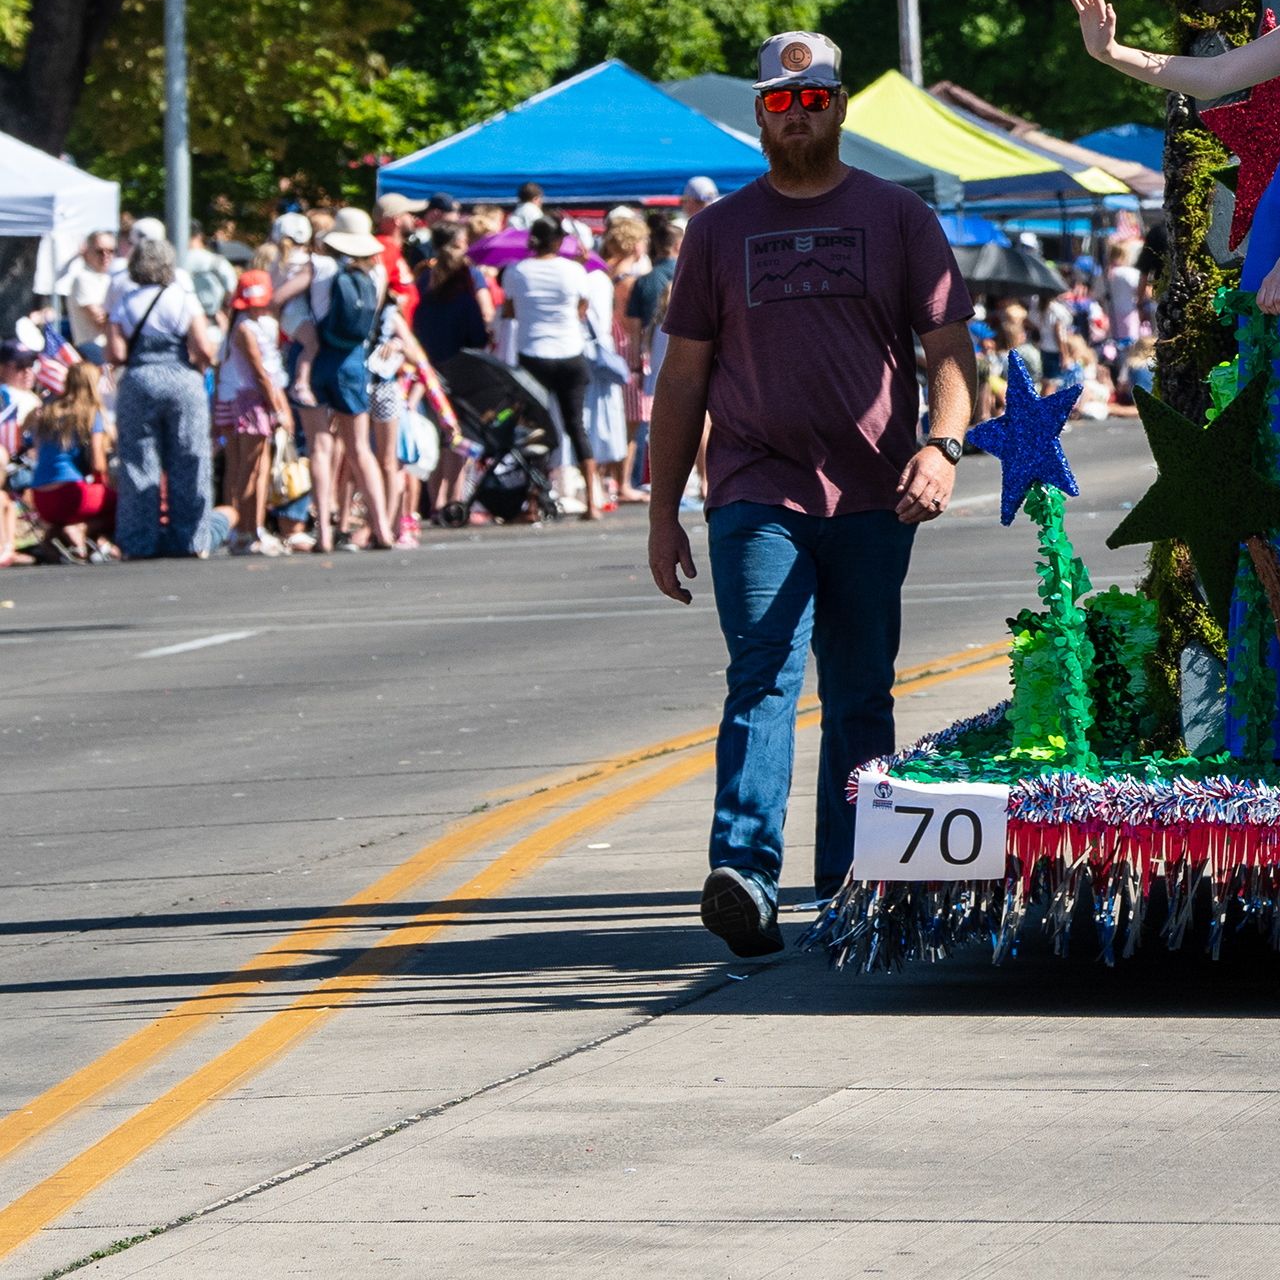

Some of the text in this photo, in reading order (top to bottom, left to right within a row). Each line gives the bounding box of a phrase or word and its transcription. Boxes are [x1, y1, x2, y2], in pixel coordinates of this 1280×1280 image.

[754, 235, 857, 255] MTN OPS
[894, 805, 983, 866] 70
